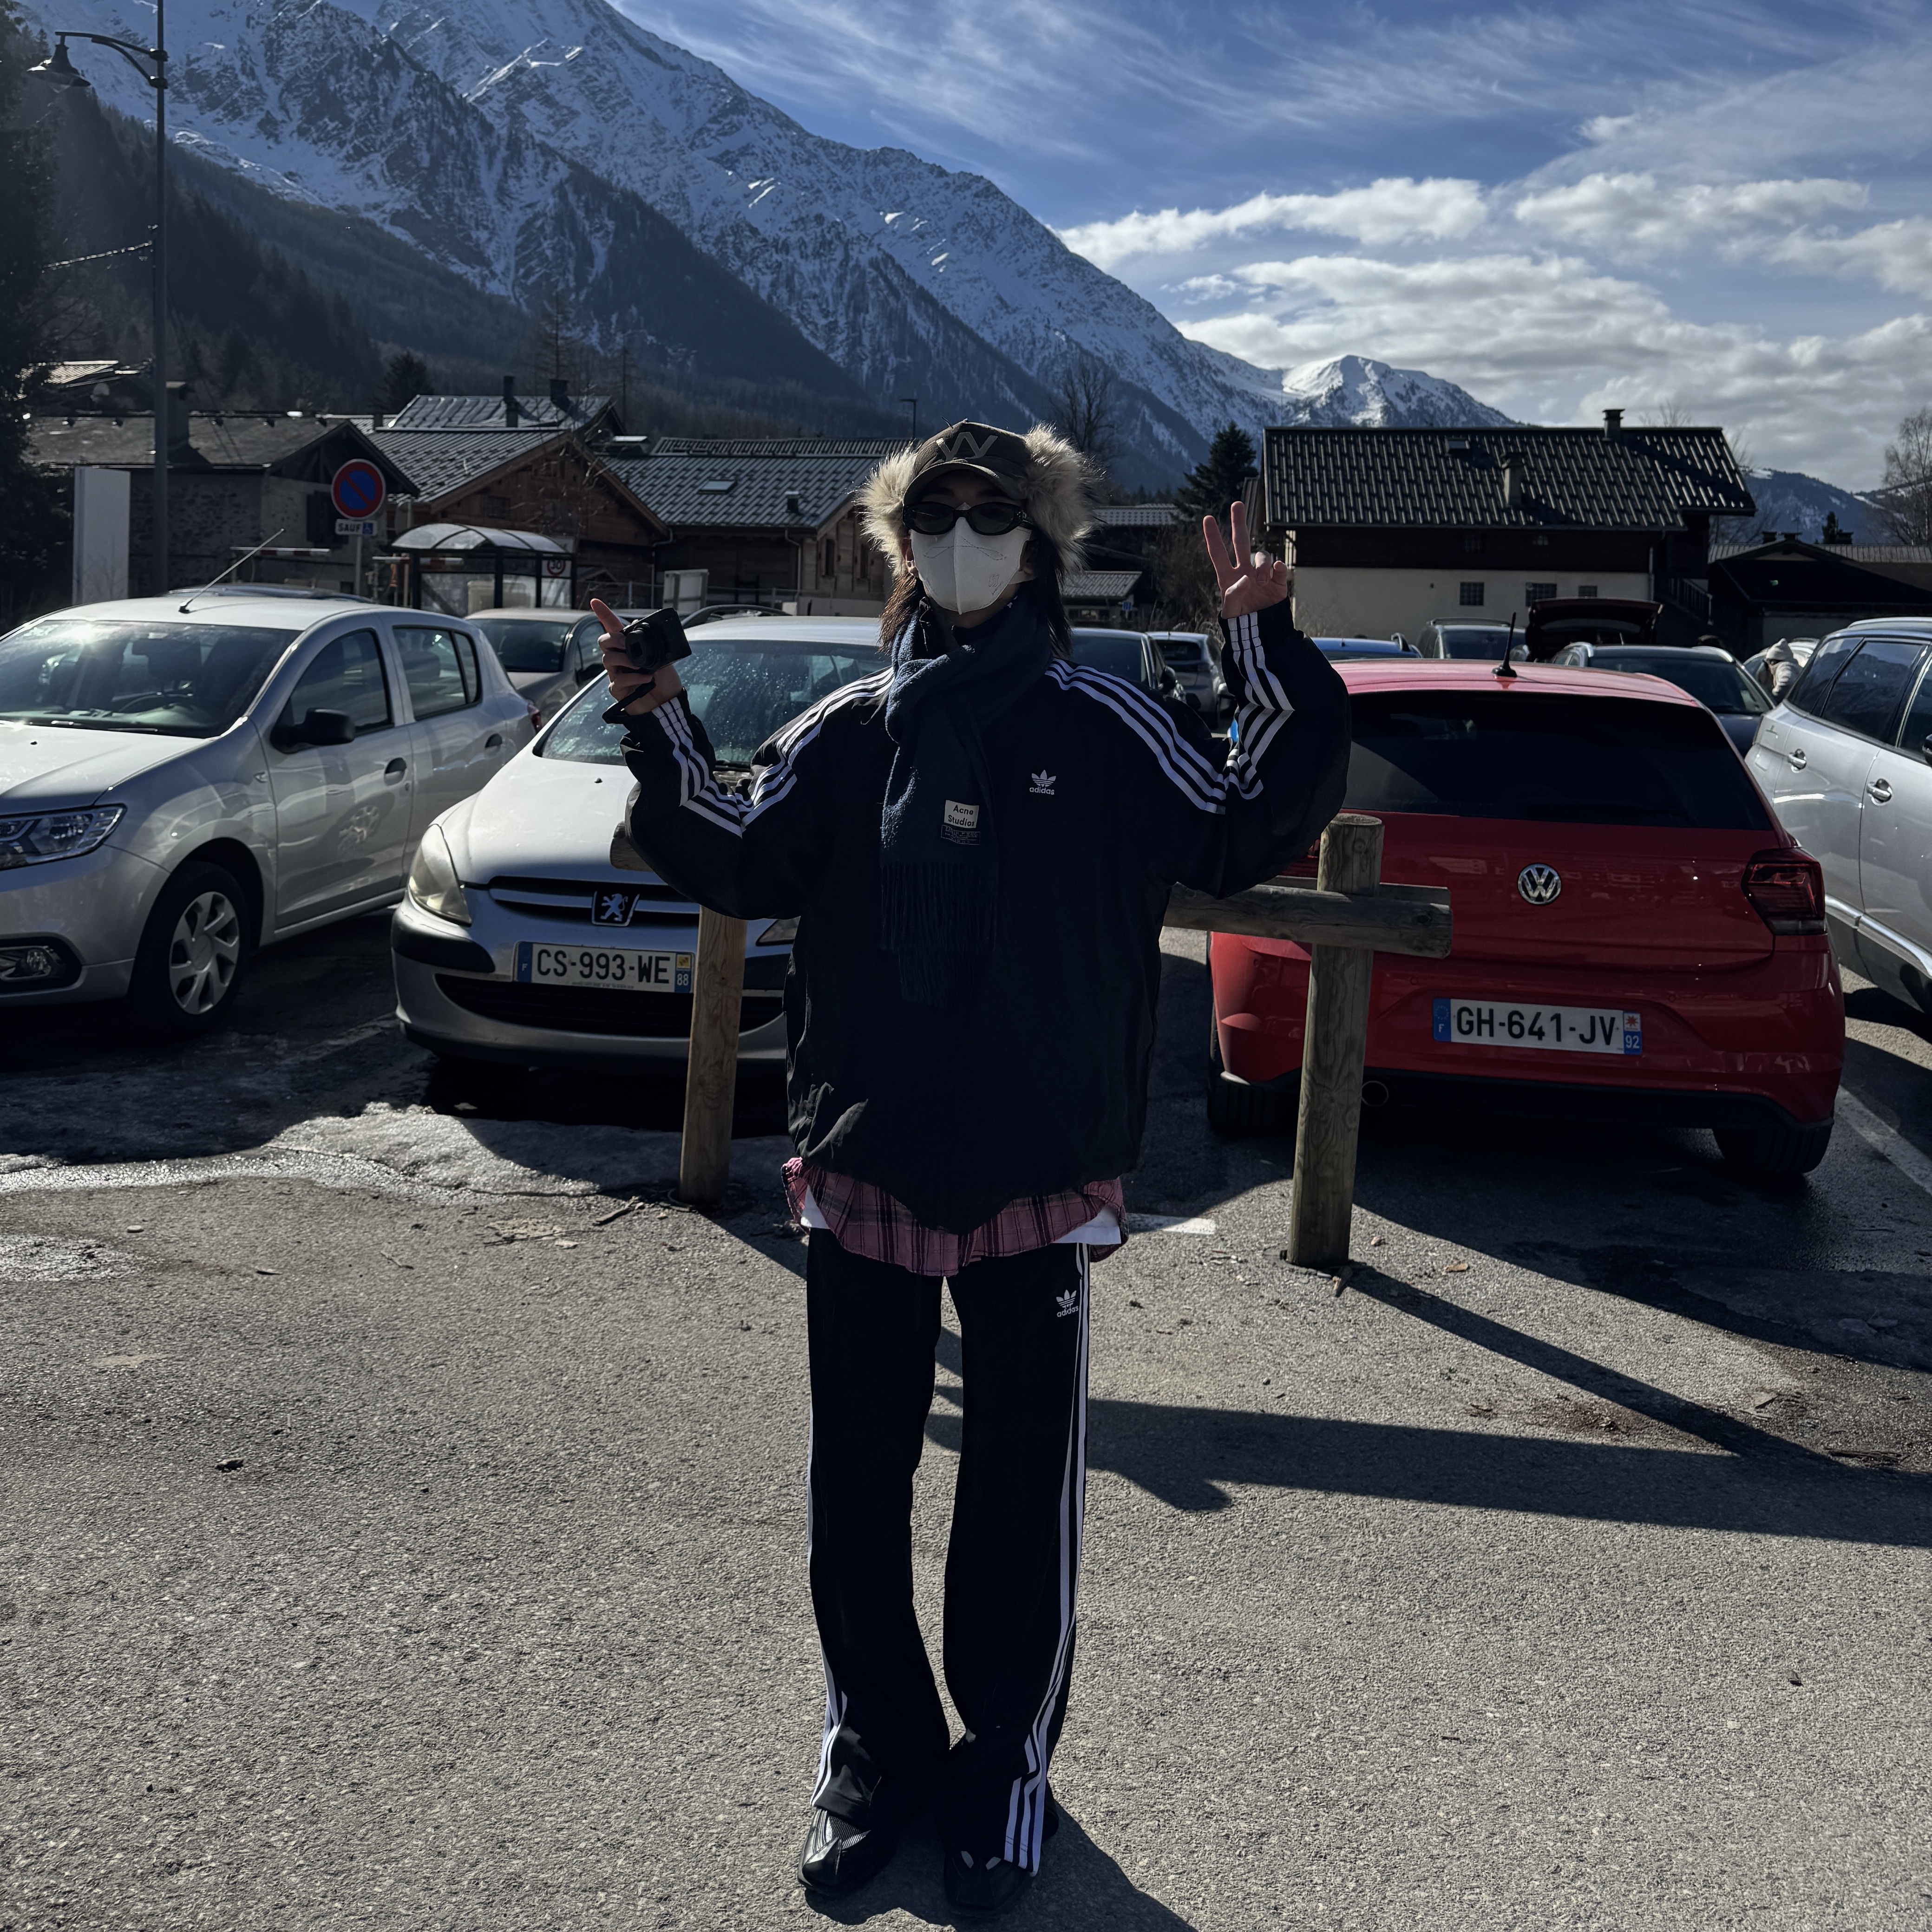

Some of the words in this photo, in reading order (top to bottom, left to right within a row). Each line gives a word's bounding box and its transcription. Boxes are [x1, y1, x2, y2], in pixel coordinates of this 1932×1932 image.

[338, 523, 361, 532] SAUF
[1029, 786, 1055, 795] adidas
[537, 949, 670, 984] CS-993-WE
[677, 973, 688, 986] 88
[1439, 1024, 1445, 1032] F
[1457, 1006, 1616, 1045] GH-641-JV
[1625, 1034, 1640, 1049] 92
[1056, 1305, 1079, 1318] adidas
